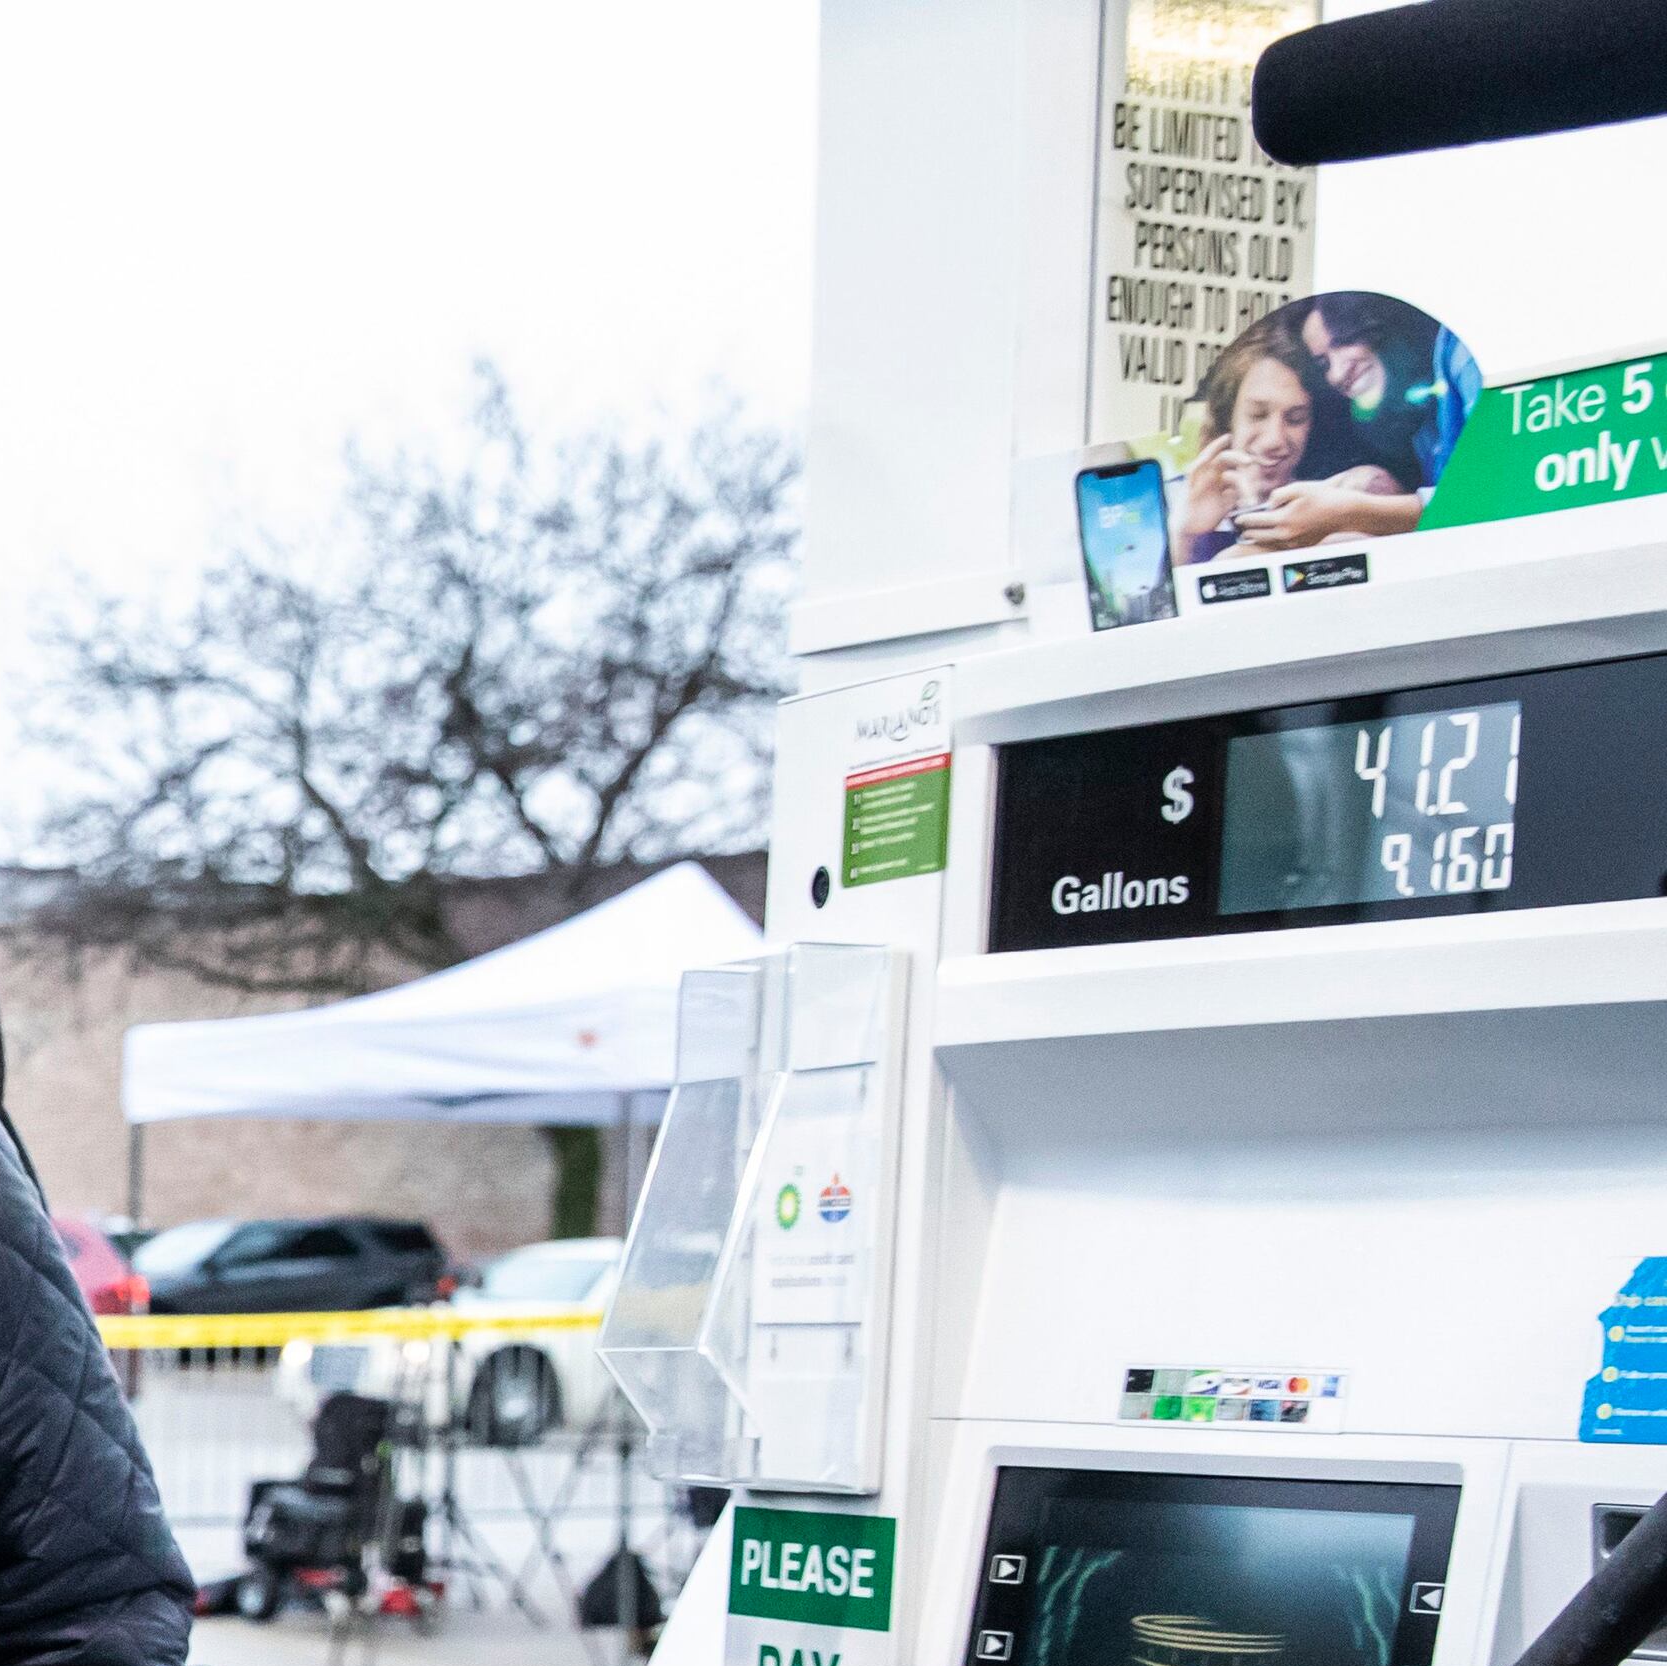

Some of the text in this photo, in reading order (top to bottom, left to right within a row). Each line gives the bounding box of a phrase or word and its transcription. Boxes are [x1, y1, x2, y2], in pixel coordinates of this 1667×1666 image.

[1114, 102, 1140, 151] BE
[1148, 107, 1239, 163] LIMITED
[1125, 161, 1265, 222] SUPERVISED
[1134, 220, 1294, 283] PERSONS OLD
[1108, 274, 1196, 330] ENOUGH
[1202, 283, 1230, 334] TO
[1119, 333, 1185, 386] VALID
[1500, 361, 1654, 435] Take 5
[1534, 429, 1642, 492] only
[1160, 765, 1195, 825] $
[1051, 871, 1190, 915] Gallons
[740, 1538, 877, 1599] PLEASE
